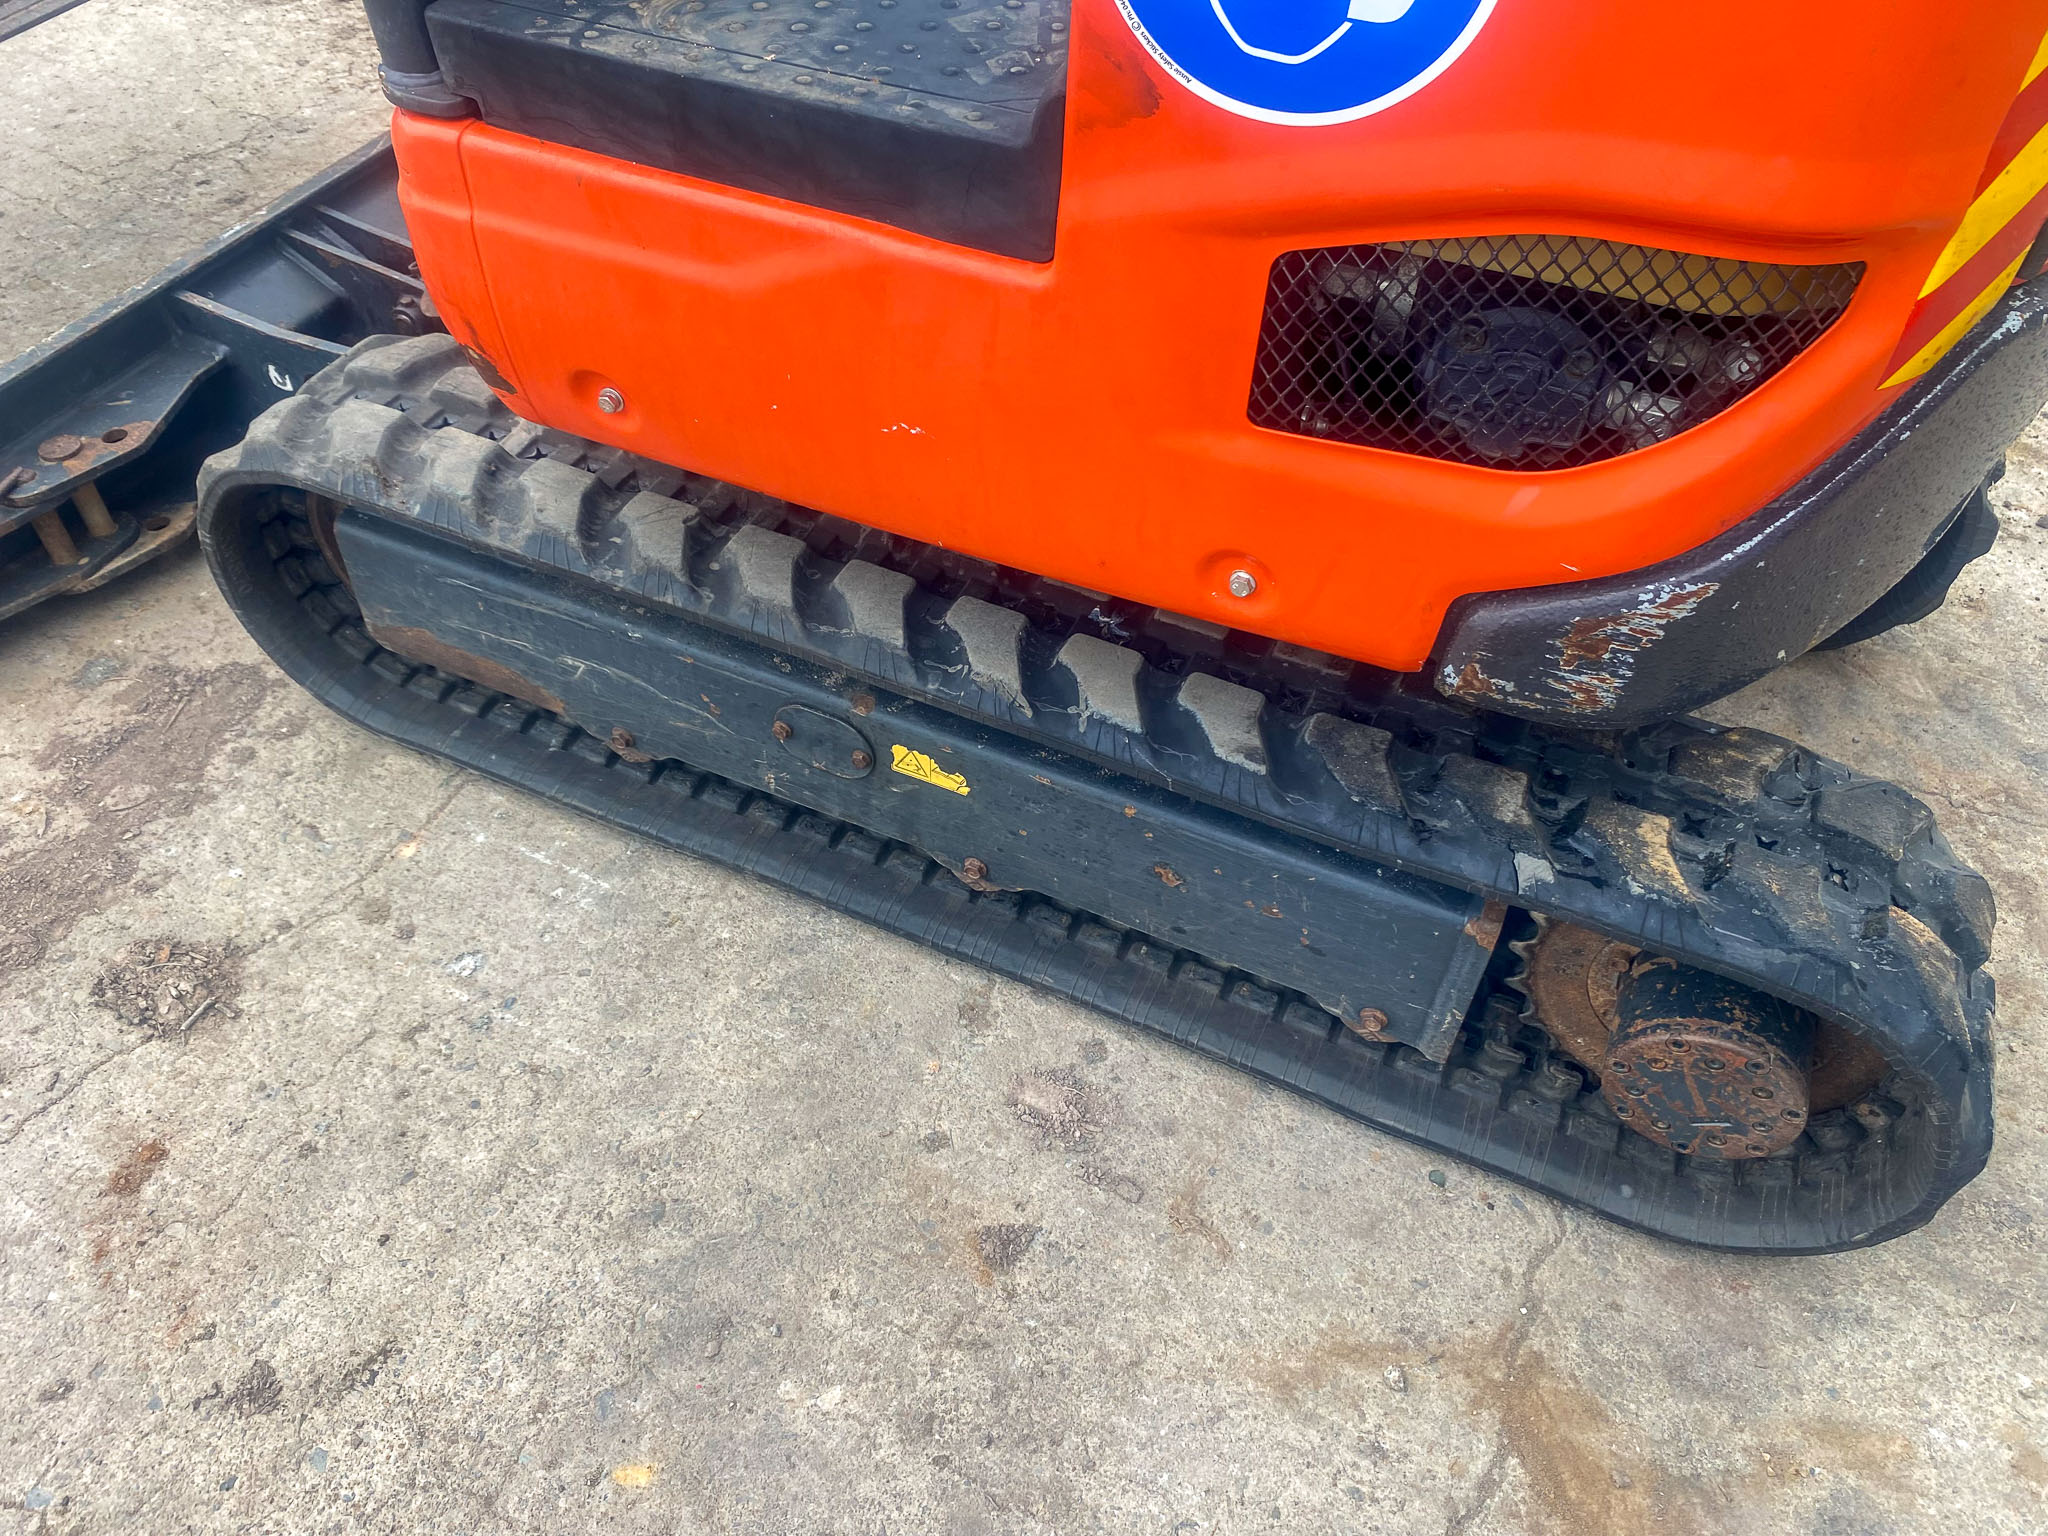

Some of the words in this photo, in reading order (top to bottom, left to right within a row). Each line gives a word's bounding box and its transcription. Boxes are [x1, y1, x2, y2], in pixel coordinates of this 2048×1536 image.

[1140, 31, 1159, 54] Stickers
[1158, 52, 1174, 70] Safety
[1174, 67, 1192, 84] Aussie
